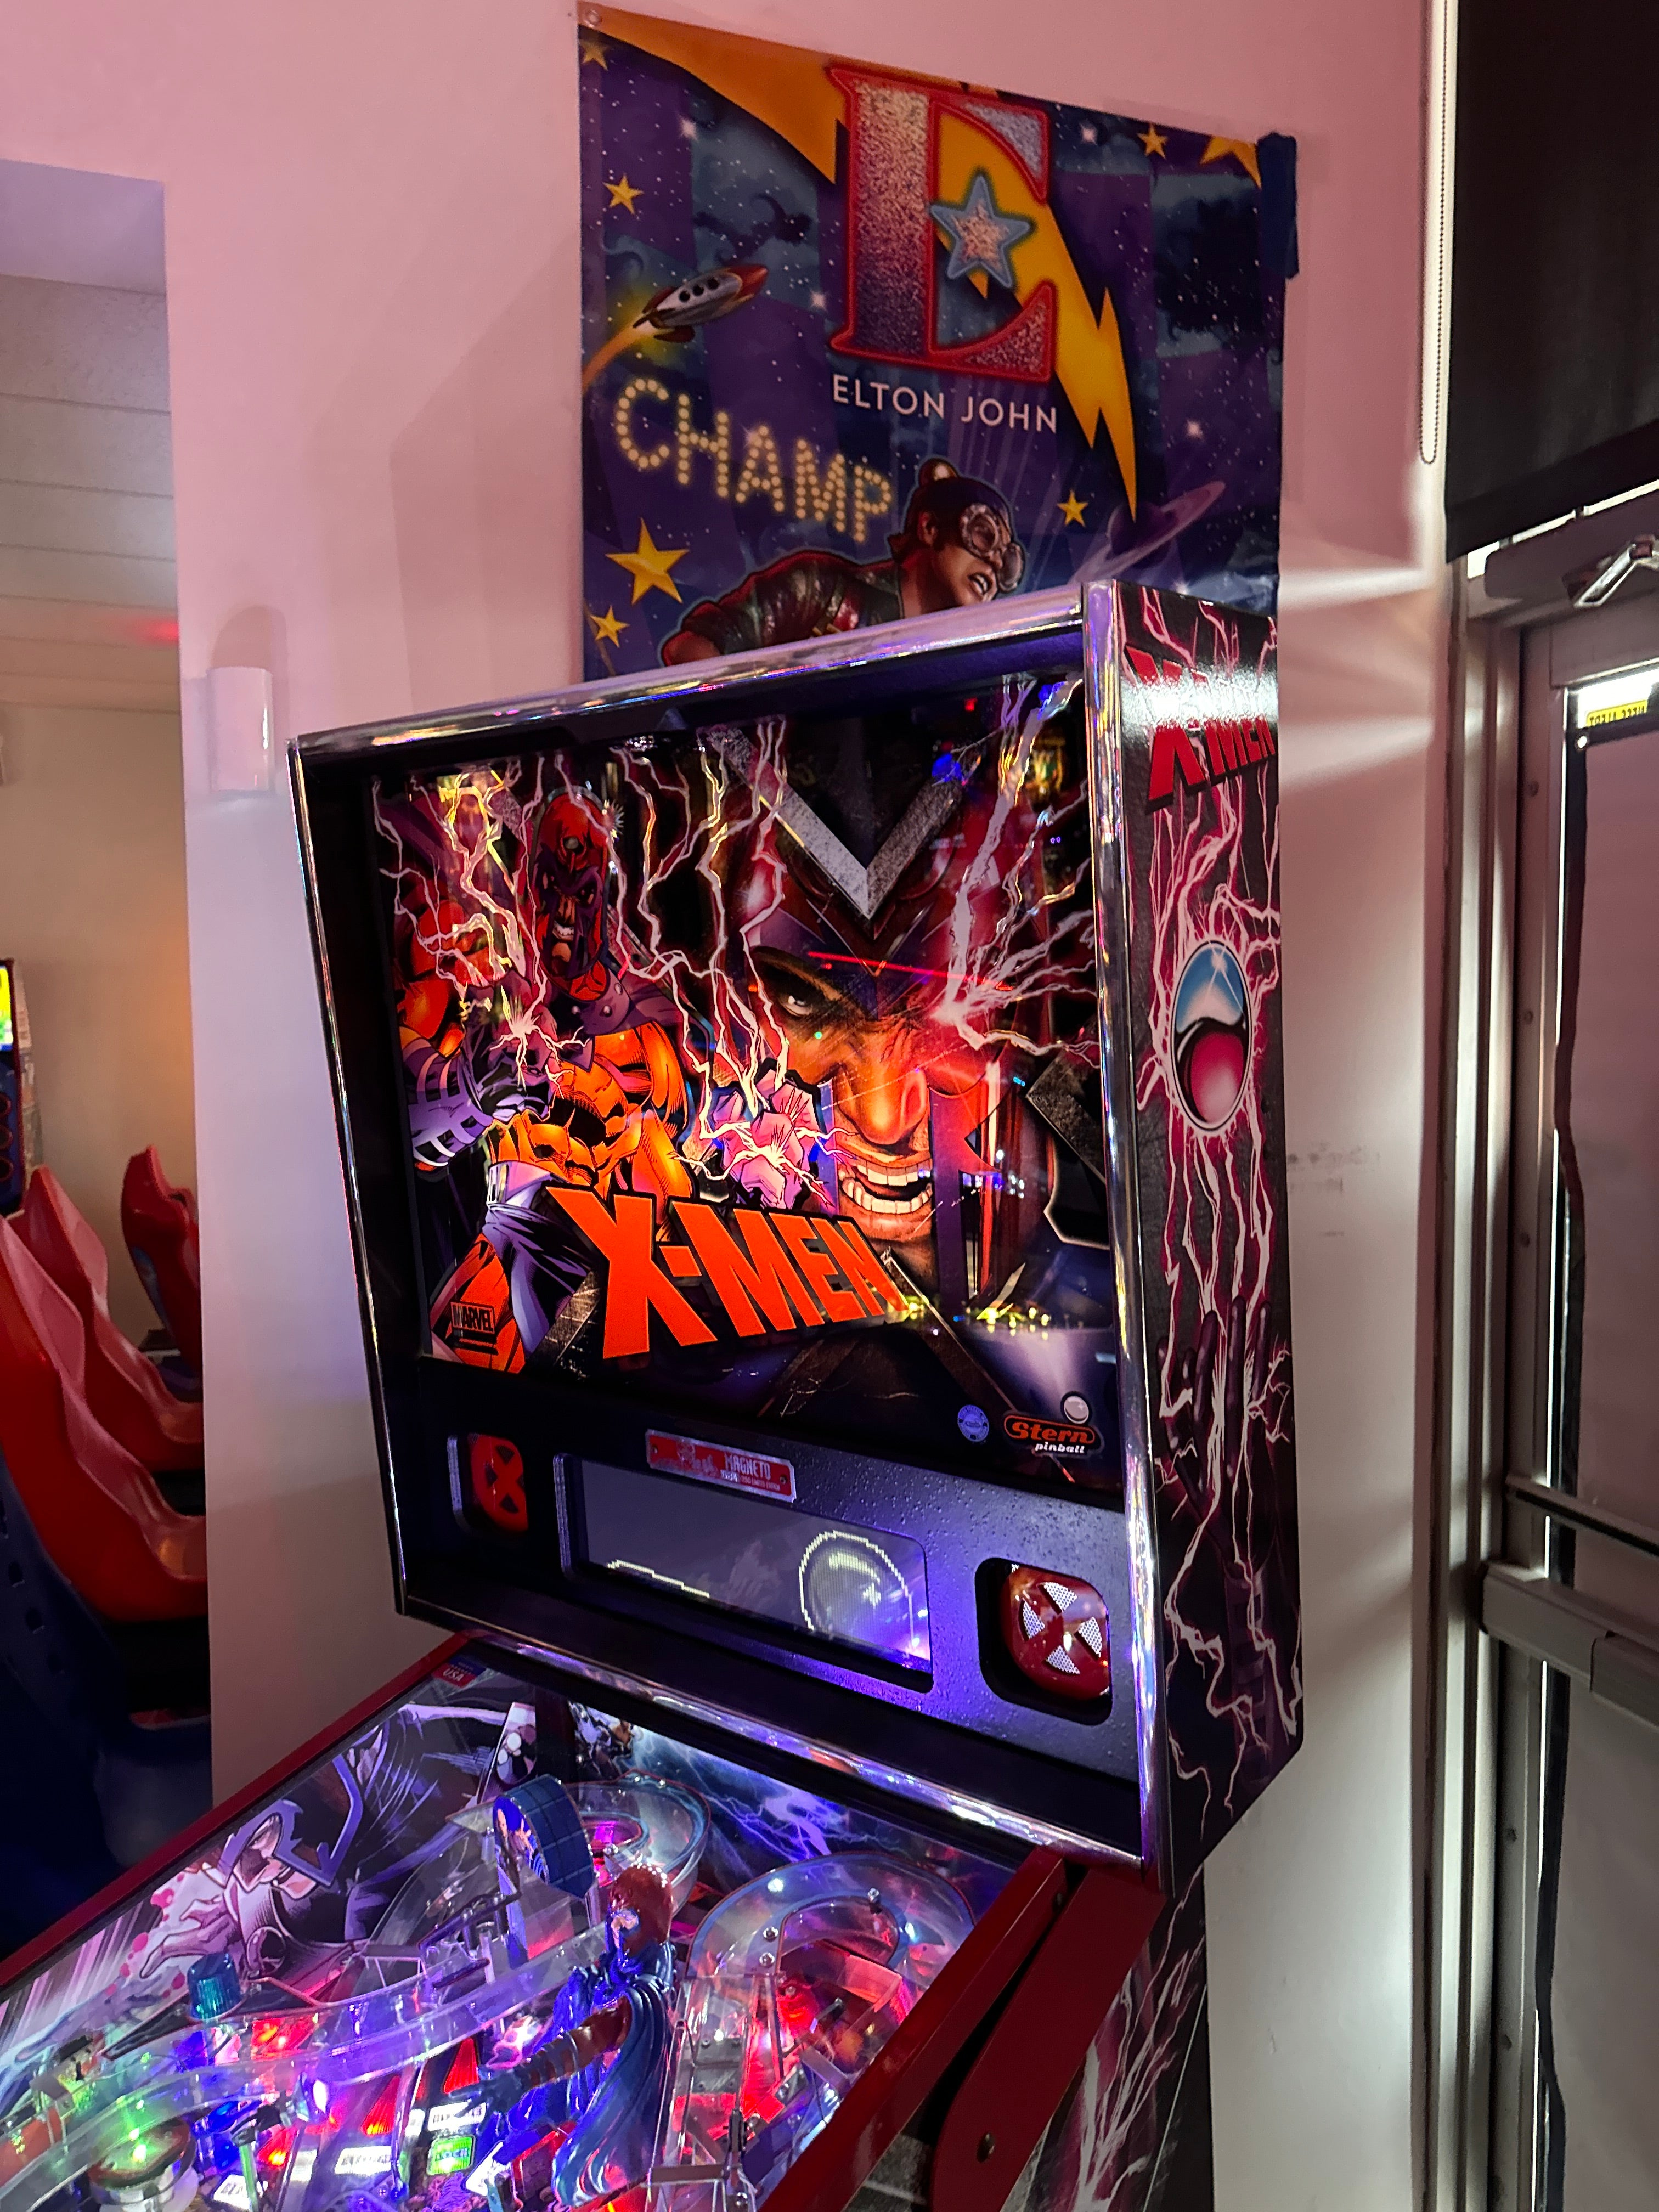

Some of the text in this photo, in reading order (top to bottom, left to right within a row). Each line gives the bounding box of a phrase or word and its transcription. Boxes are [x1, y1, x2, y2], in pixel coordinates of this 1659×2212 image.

[825, 64, 1057, 383] E
[832, 374, 1057, 434] ELTON JOHN
[615, 378, 892, 543] CHAMP
[1126, 645, 1276, 801] XMEN
[545, 1186, 910, 1359] X-MEN
[452, 1304, 494, 1333] MARVEL
[1012, 1421, 1090, 1444] Stern
[1035, 1442, 1085, 1454] pinball
[724, 1452, 771, 1481] MAGNETO
[442, 1668, 465, 1682] USA
